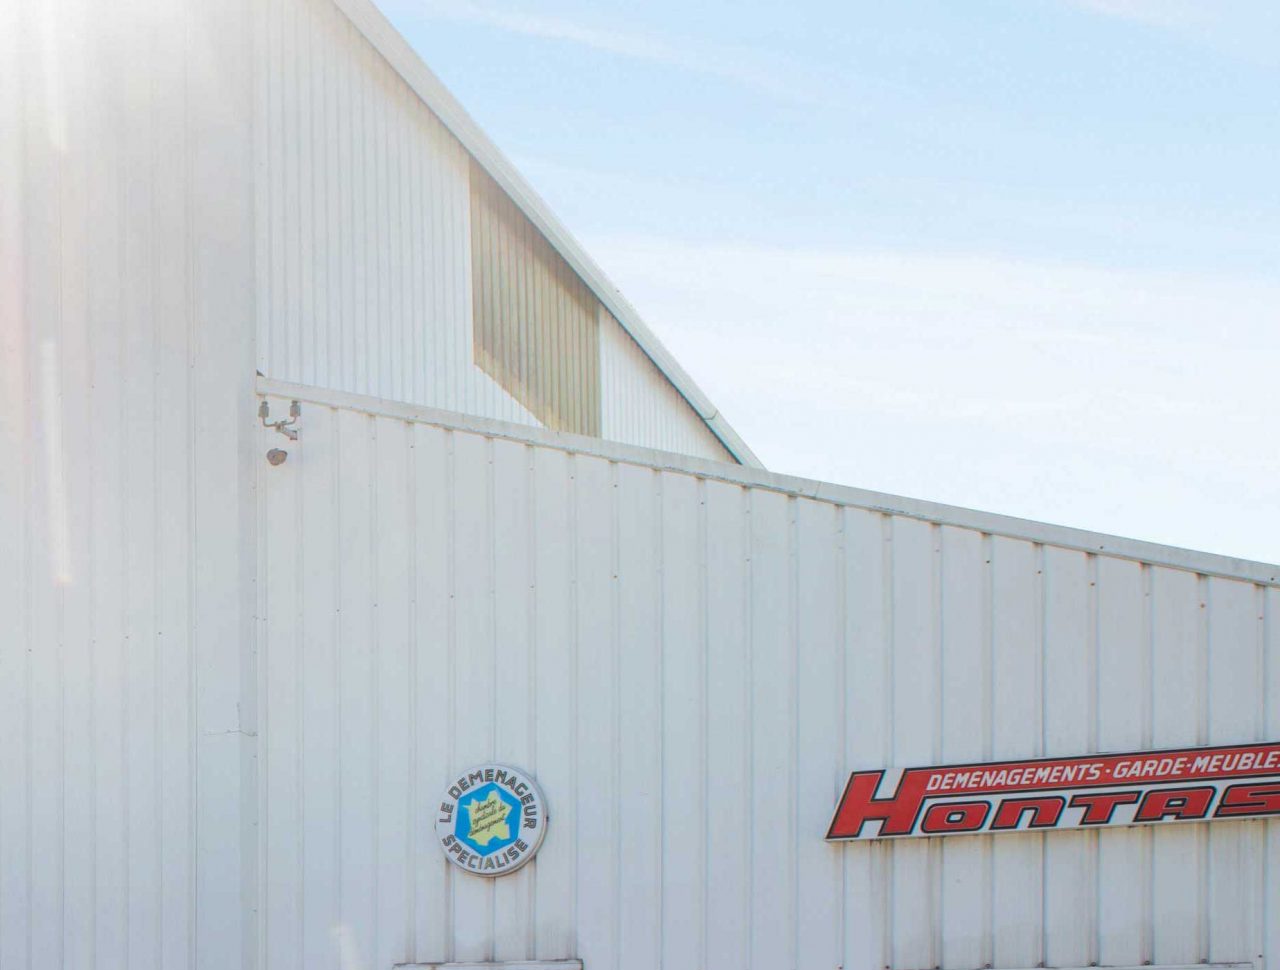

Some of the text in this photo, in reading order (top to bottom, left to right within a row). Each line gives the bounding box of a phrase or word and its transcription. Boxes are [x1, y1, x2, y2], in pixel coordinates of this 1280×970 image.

[926, 751, 1280, 791] DEMENAGEMENTS GARDE-MEUBLE
[439, 802, 454, 823] LE
[448, 769, 537, 829] DEMENAGEUR
